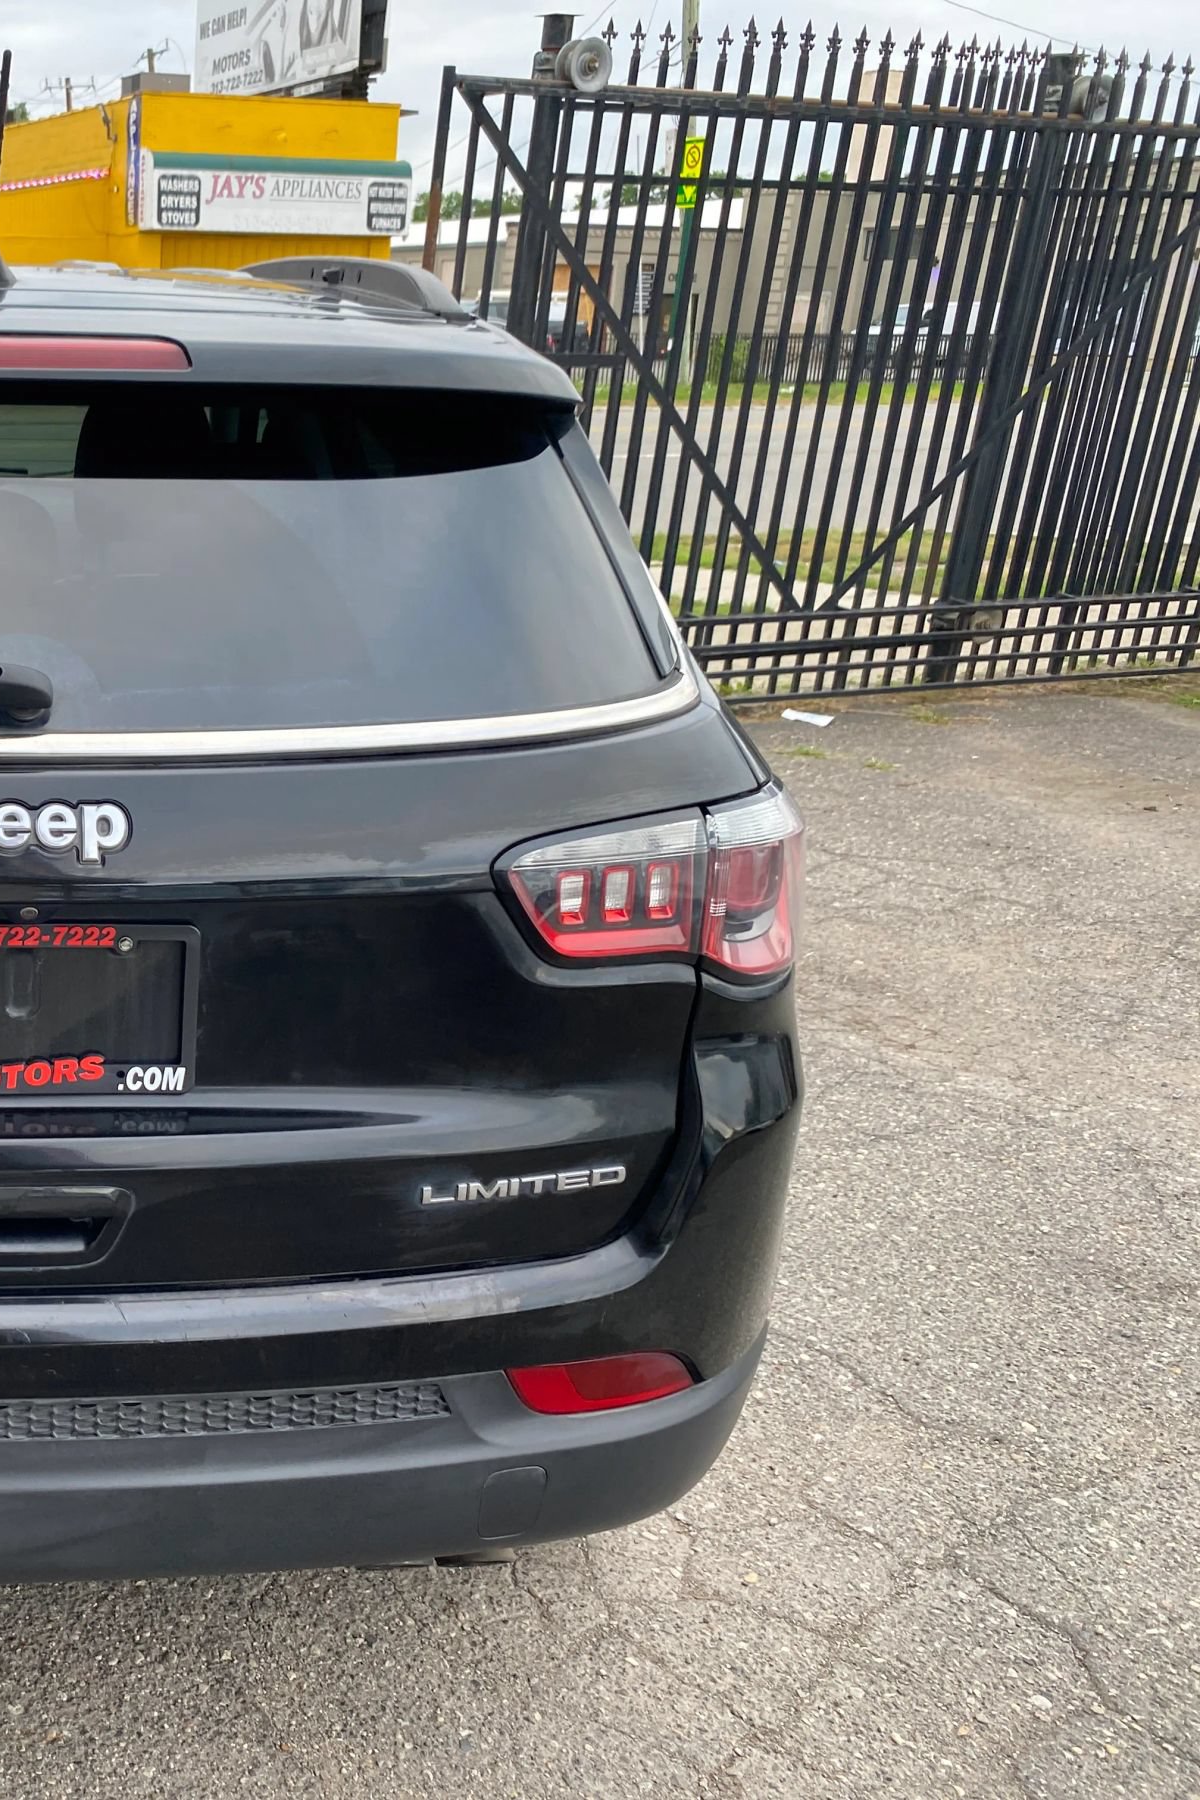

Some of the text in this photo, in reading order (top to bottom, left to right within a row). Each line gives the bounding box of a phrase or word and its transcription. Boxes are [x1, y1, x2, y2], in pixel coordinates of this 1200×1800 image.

[200, 7, 247, 40] WE CAN HELP!
[211, 49, 251, 76] MOTORS
[160, 179, 200, 193] WASHERS
[206, 175, 362, 204] JAY'S APPLIANCES
[161, 195, 198, 209] DRYERS
[161, 211, 197, 225] STOVES
[117, 1066, 187, 1092] .COM
[421, 1166, 627, 1205] LIMITED
